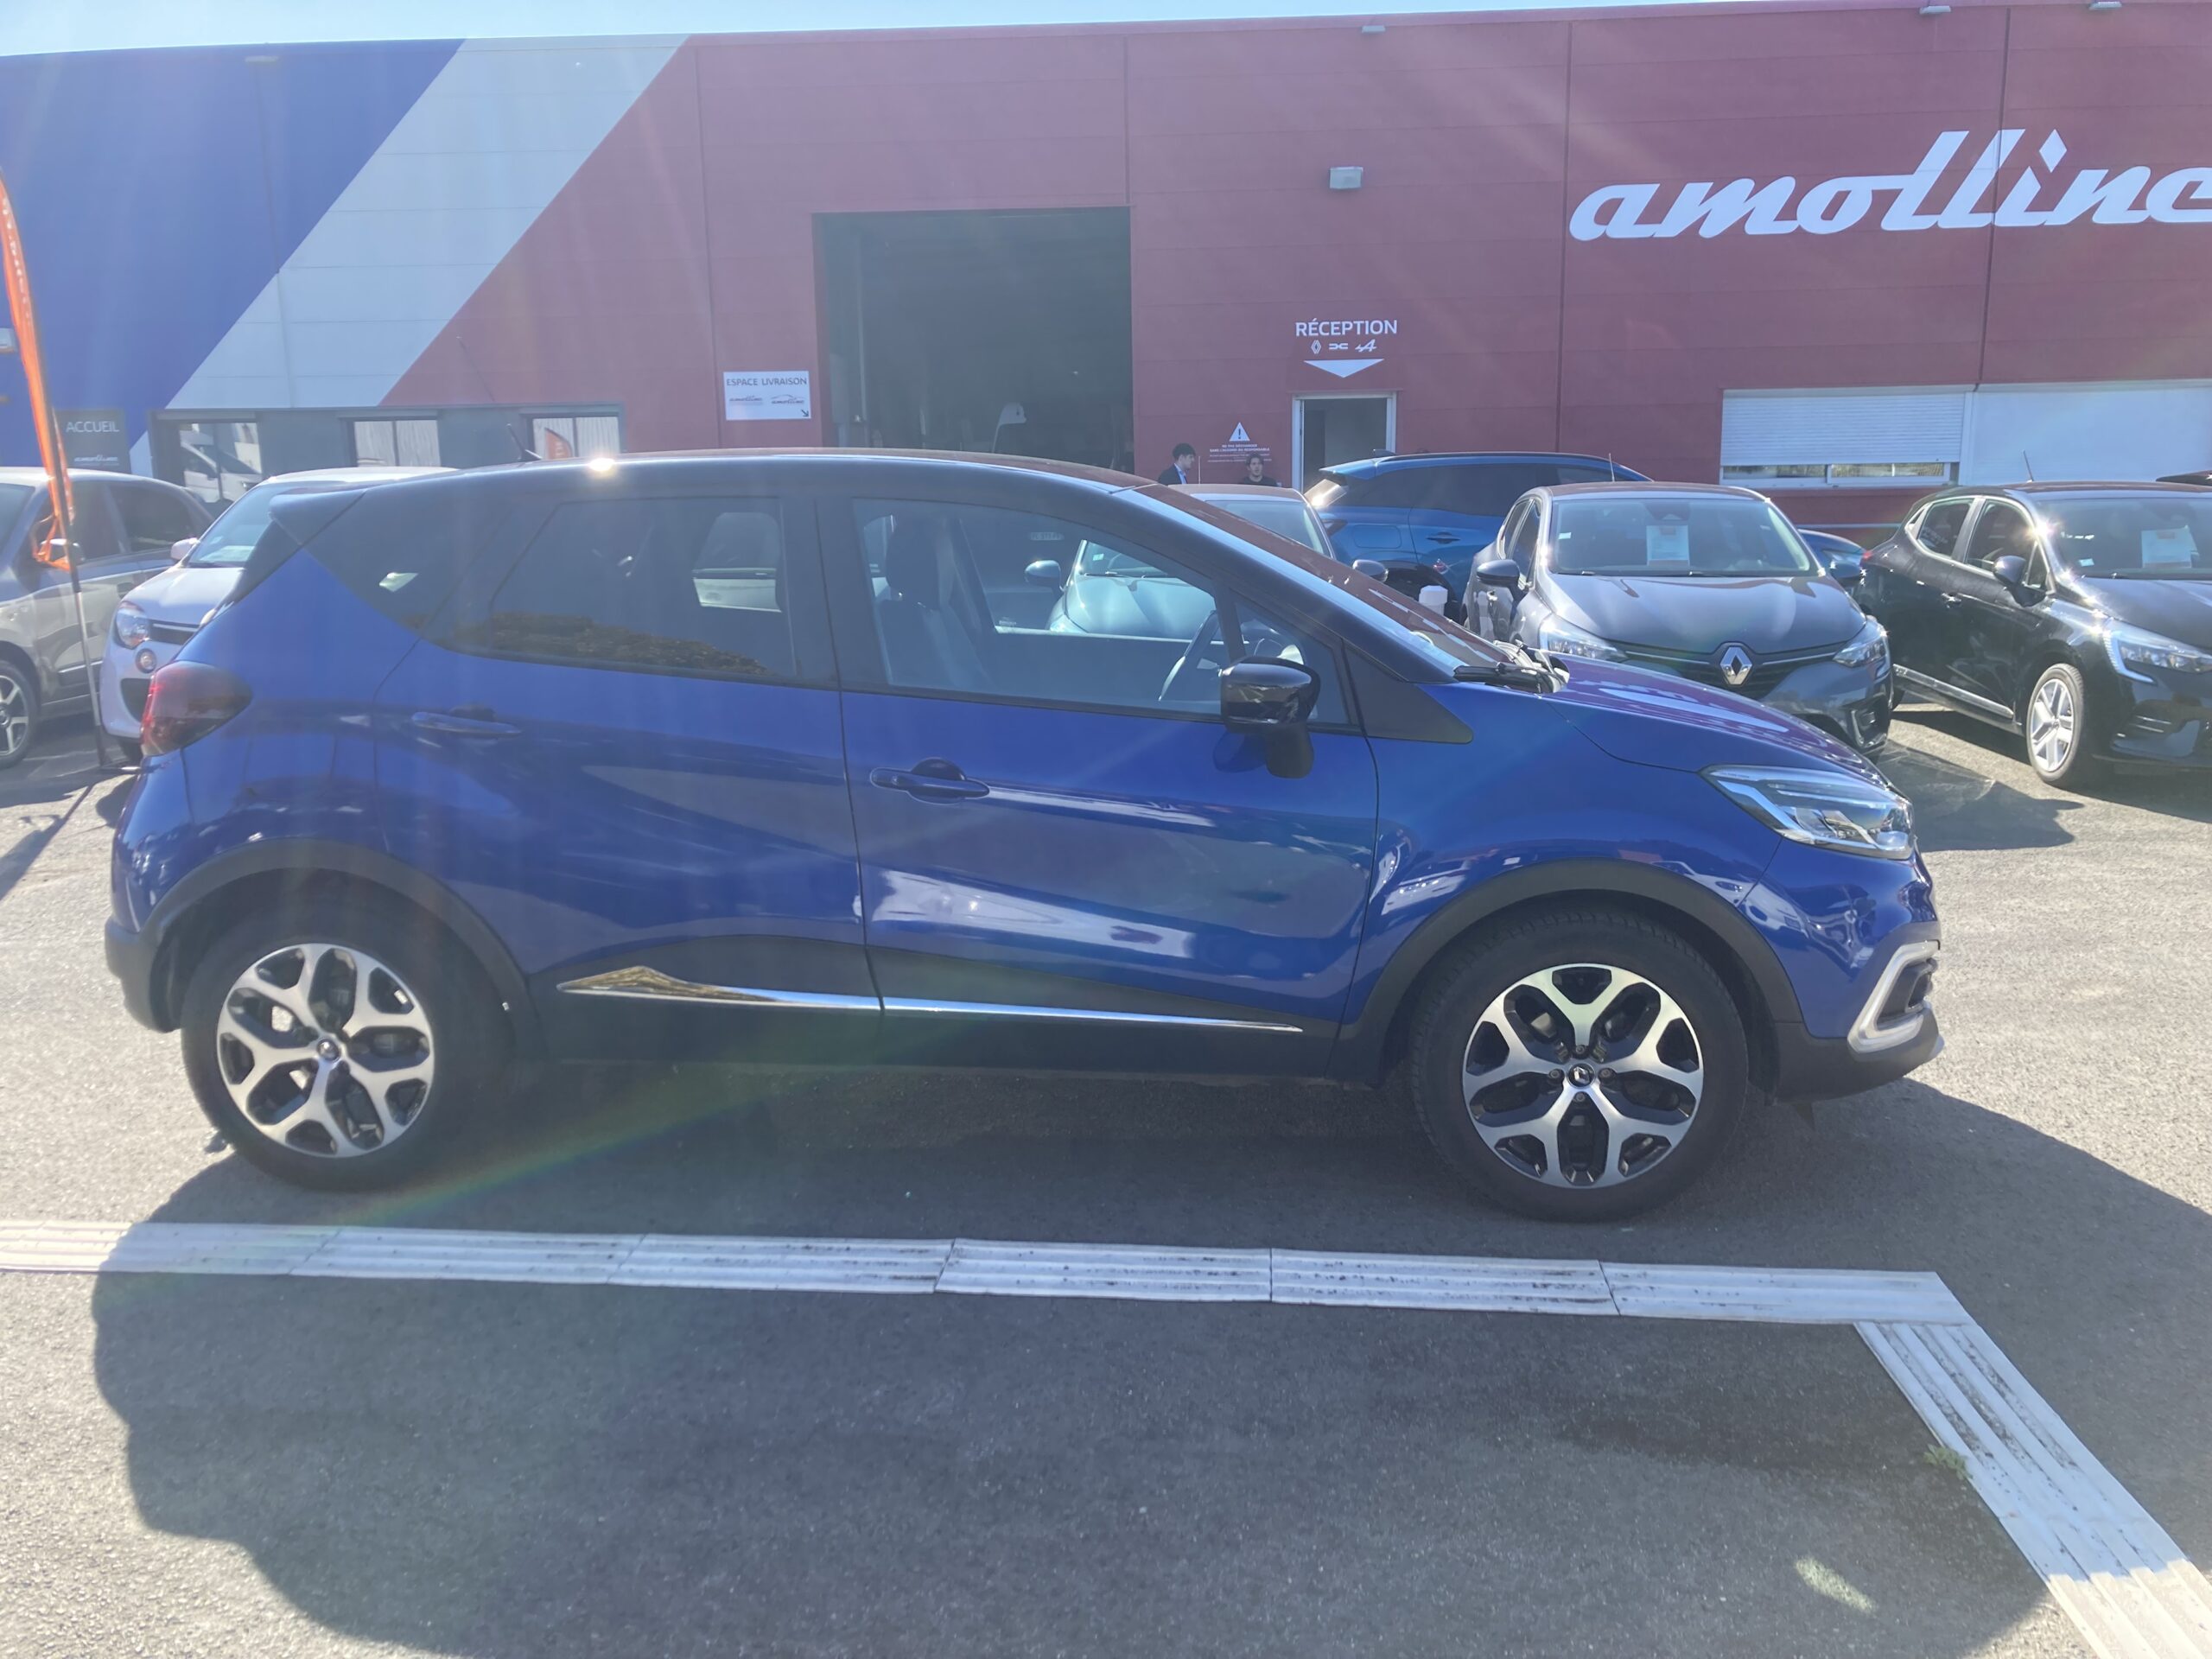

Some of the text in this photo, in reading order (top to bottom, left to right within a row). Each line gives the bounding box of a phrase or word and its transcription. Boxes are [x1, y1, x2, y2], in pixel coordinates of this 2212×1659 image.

[1569, 129, 2212, 241] amolline
[1295, 318, 1398, 337] RÉCEPTION
[761, 377, 807, 386] LIVRAISON
[66, 421, 120, 433] ACCUEIL
